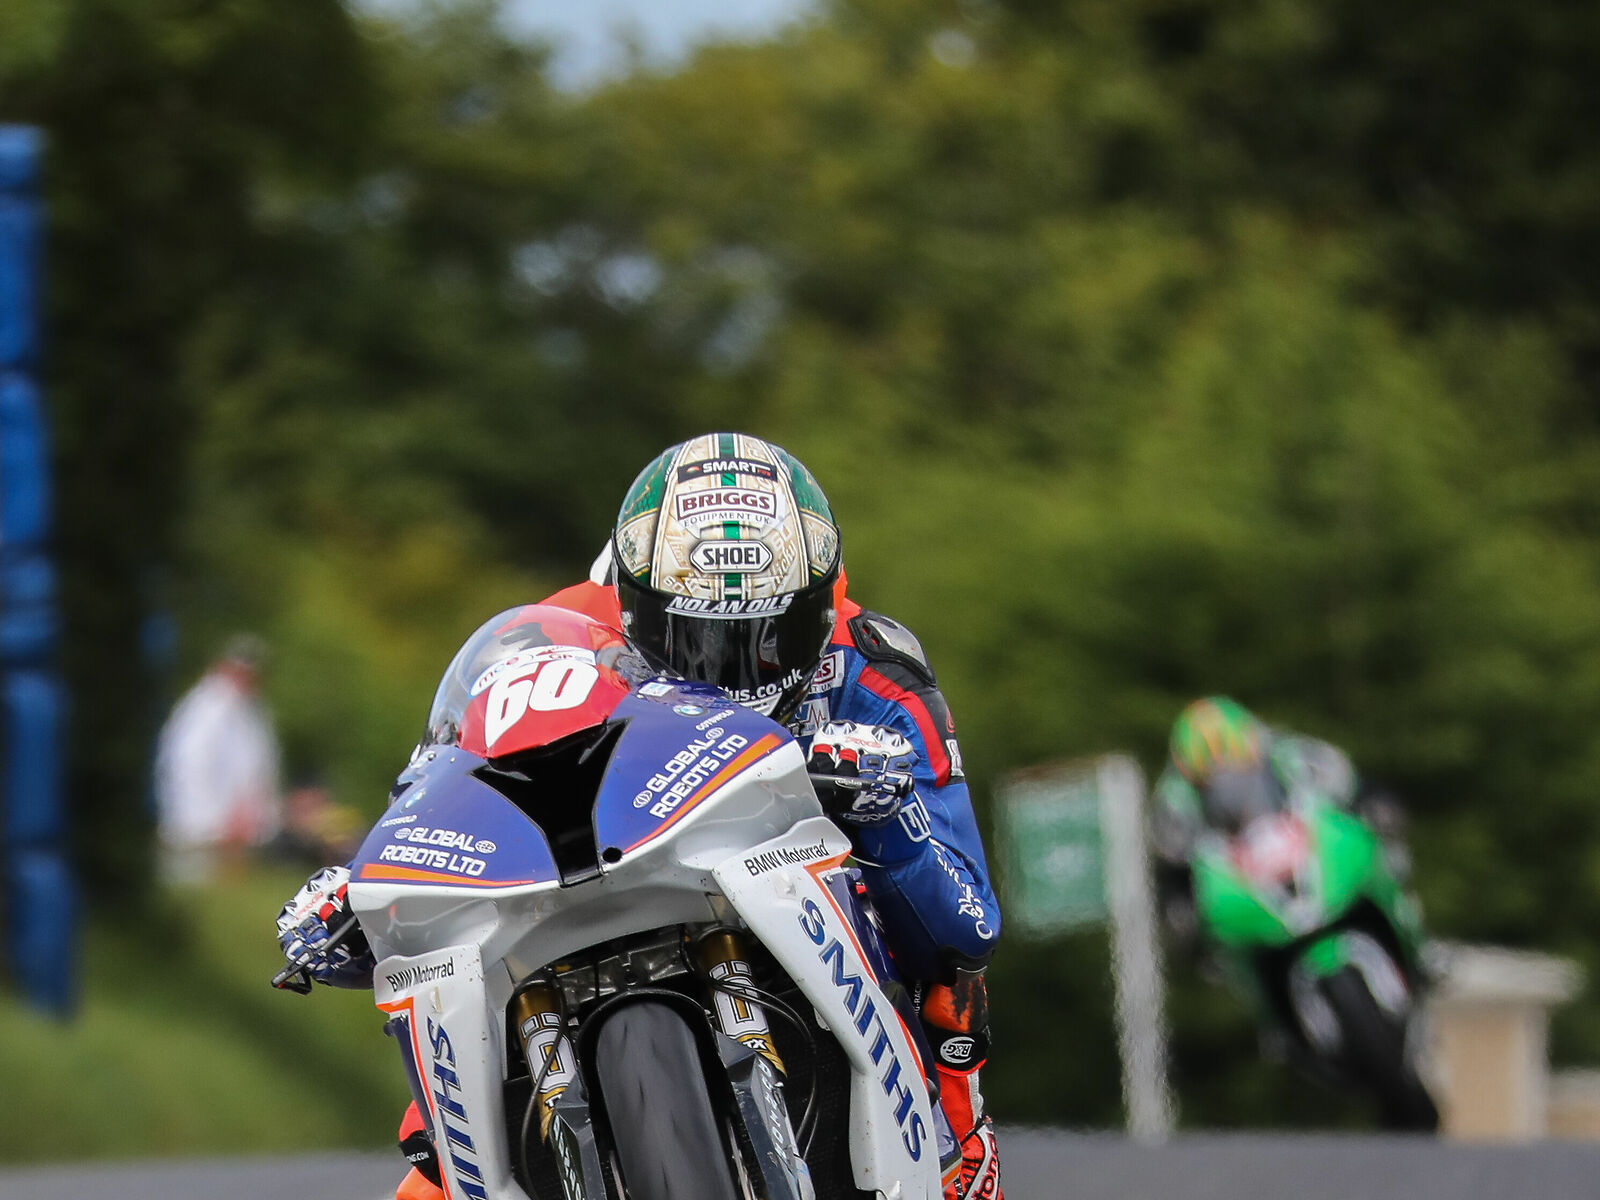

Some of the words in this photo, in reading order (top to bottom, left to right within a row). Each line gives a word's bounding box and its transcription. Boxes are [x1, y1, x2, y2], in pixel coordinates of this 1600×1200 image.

[703, 461, 770, 473] SMART
[682, 492, 770, 511] BRIGGS
[684, 512, 750, 527] EQUIPMENT
[755, 514, 770, 524] UK
[703, 547, 761, 566] SHOEI
[669, 595, 746, 613] NOLAN
[745, 592, 795, 613] OILS
[484, 661, 600, 749] 60
[645, 739, 716, 793] GLOBAL
[649, 756, 721, 819] ROBOTS
[711, 734, 749, 760] LTD
[408, 827, 475, 853] GLOBAL
[379, 844, 451, 869] ROBOTS
[447, 854, 487, 877] LTD
[744, 850, 782, 876] BMW
[776, 838, 830, 865] Motorrad
[386, 968, 412, 992] BMW
[411, 956, 455, 985] Motorrad
[798, 896, 928, 1162] SMITHS
